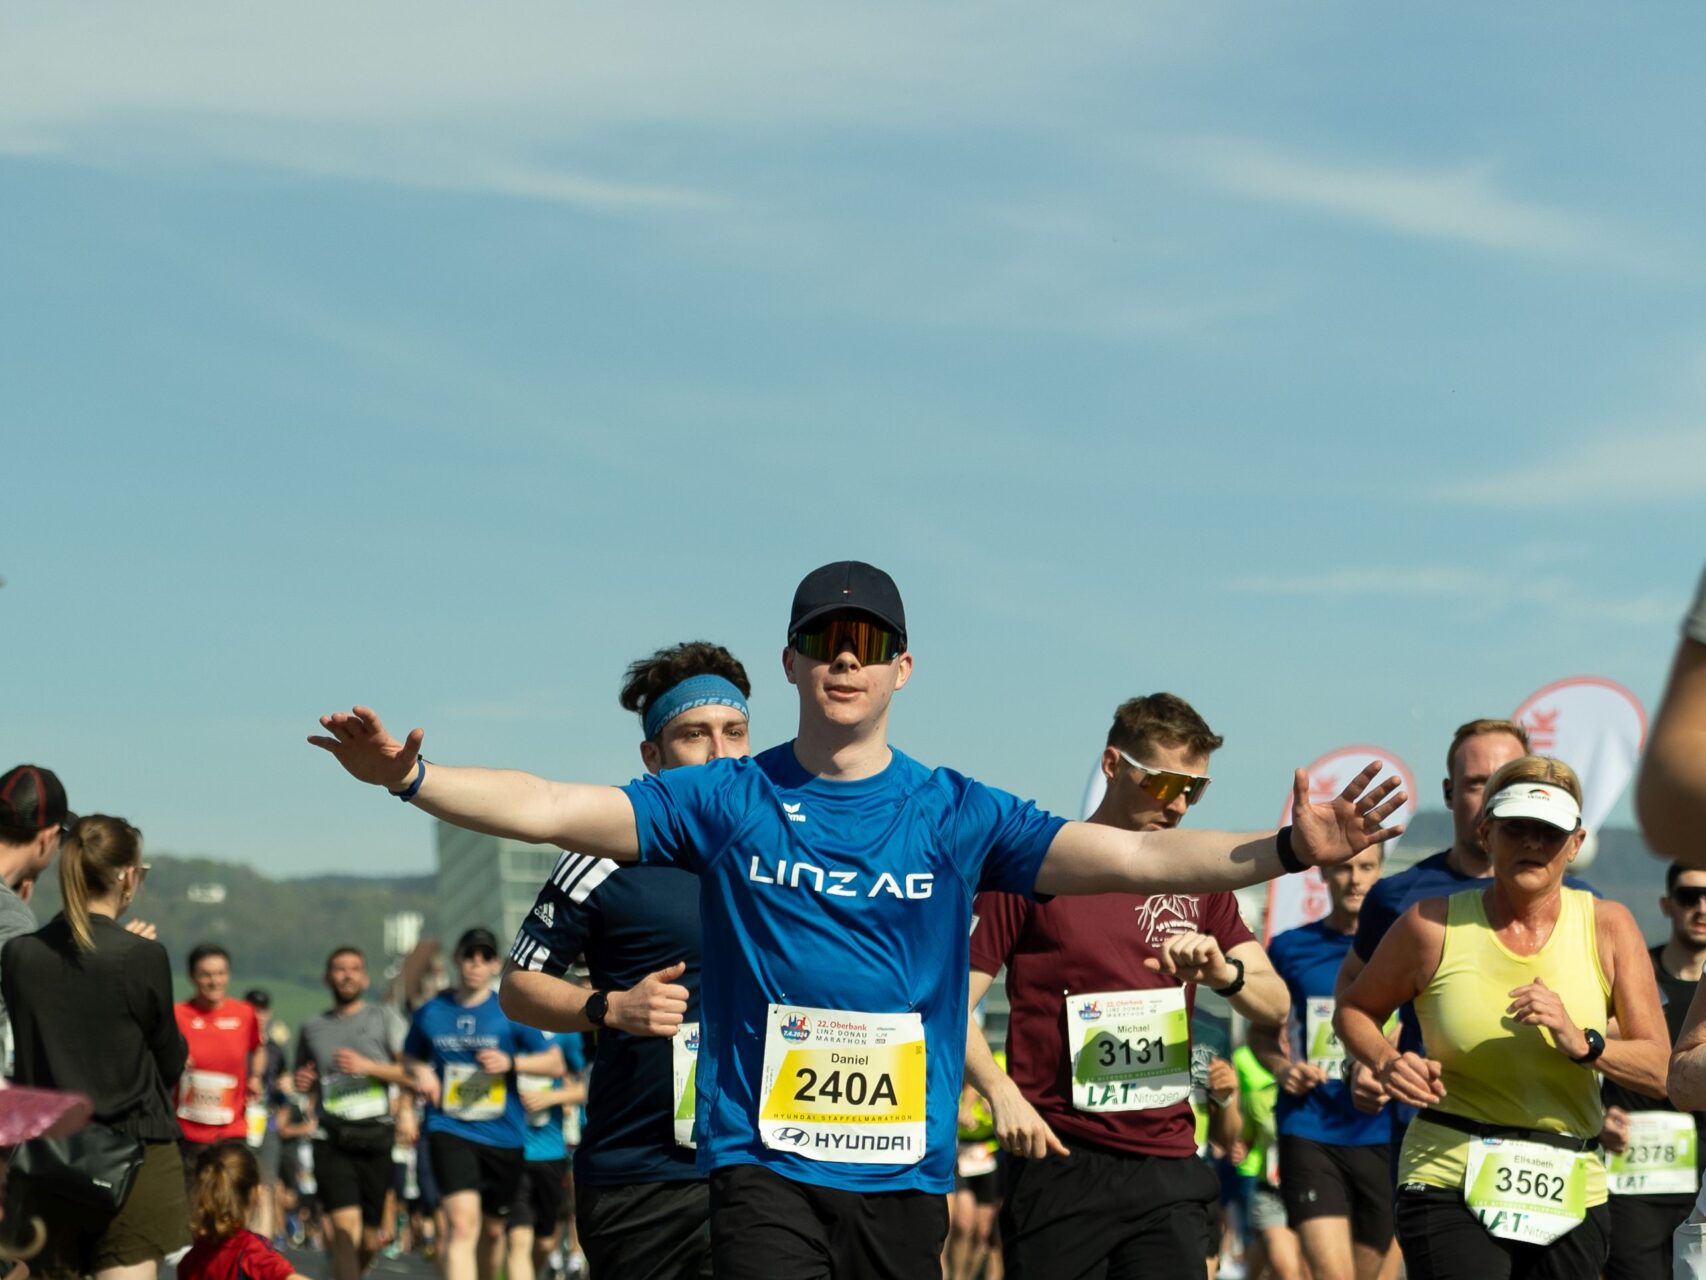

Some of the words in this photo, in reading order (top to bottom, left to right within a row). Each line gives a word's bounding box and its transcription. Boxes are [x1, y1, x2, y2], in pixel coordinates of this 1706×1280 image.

[749, 855, 858, 898] LINZ
[868, 872, 935, 900] AG
[817, 1020, 829, 1028] 22.
[830, 1021, 868, 1031] Oberbank
[1117, 1024, 1150, 1034] Michael
[815, 1036, 867, 1045] MARATHON
[838, 1031, 868, 1039] DONAU
[831, 1053, 869, 1066] Daniel
[1099, 1036, 1165, 1068] 3131
[793, 1067, 898, 1106] 240A
[1087, 1083, 1131, 1107] LAT
[1133, 1090, 1180, 1108] Nitrogen
[815, 1133, 911, 1151] HYUNDAI
[1514, 1155, 1554, 1169] Elisabeth
[1626, 1145, 1677, 1164] 2378
[1495, 1167, 1565, 1203] 3562
